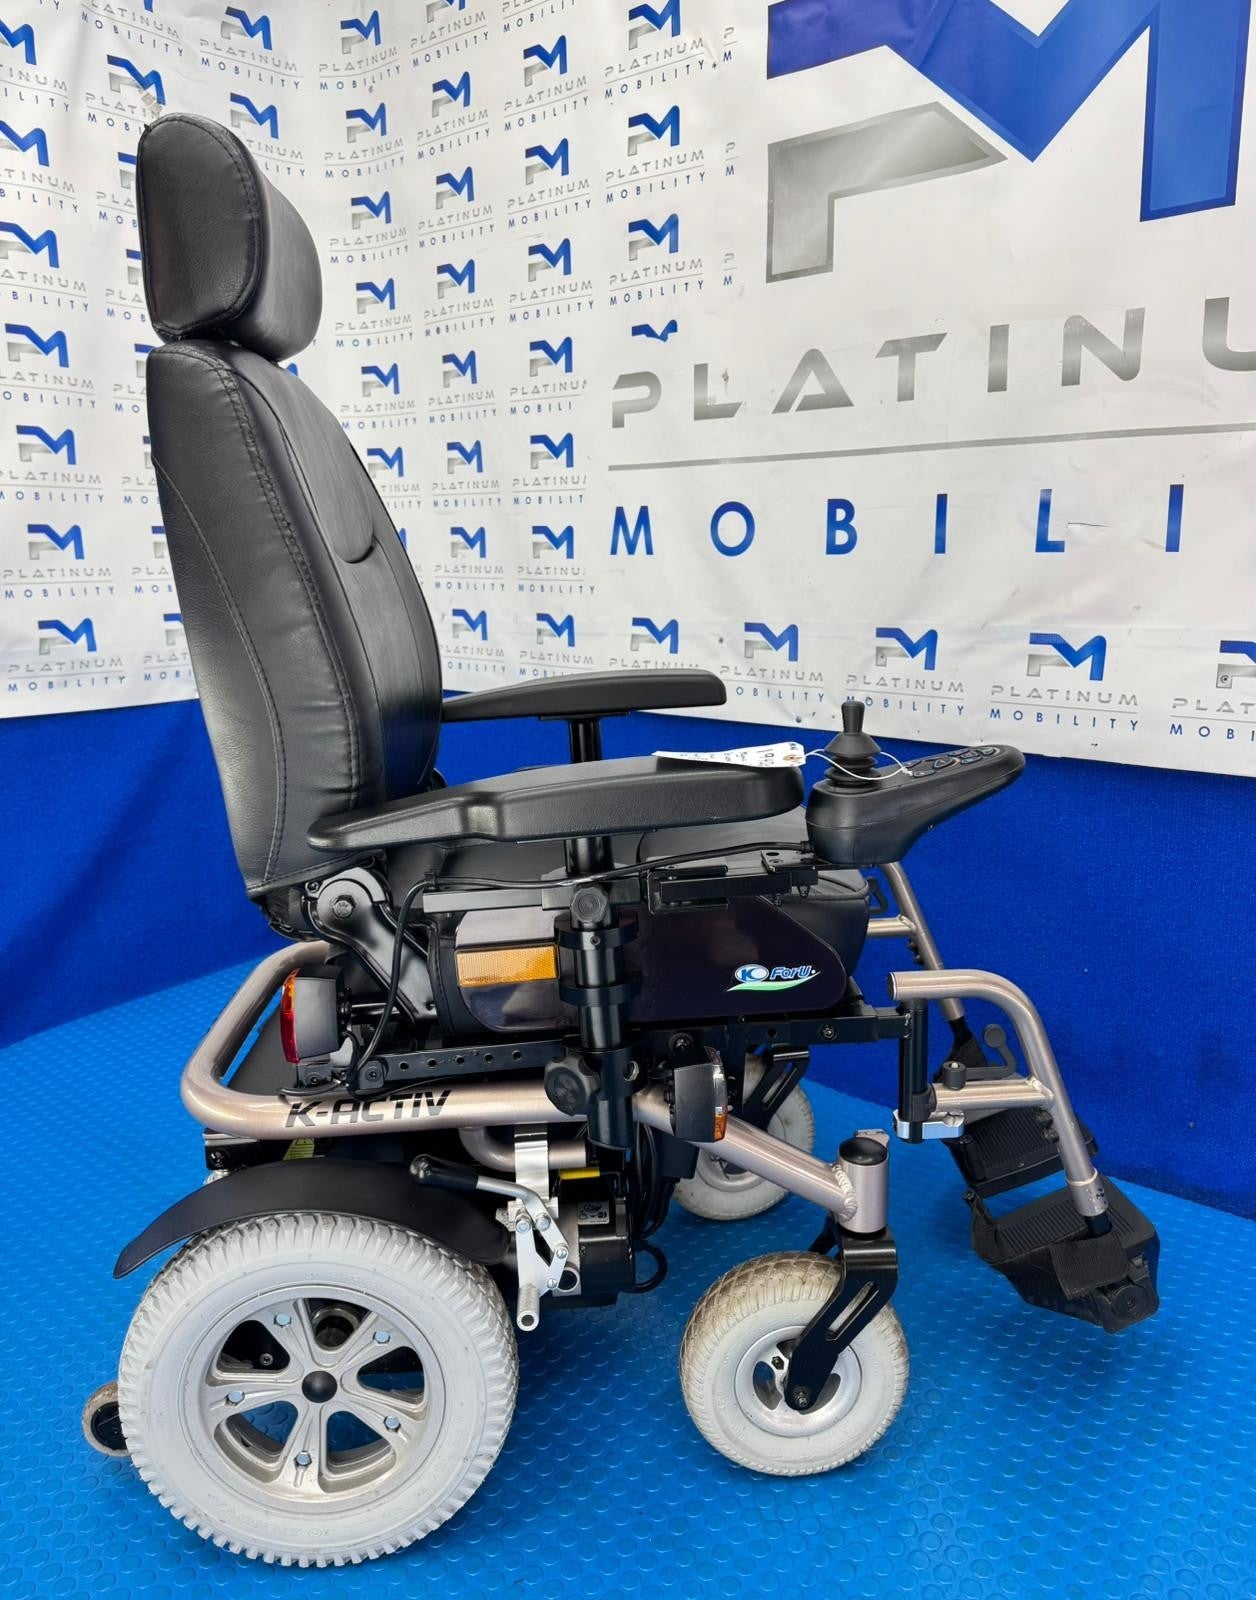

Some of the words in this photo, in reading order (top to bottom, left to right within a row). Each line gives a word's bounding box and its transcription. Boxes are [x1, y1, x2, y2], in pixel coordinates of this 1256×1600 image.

[91, 0, 180, 38] LATINUM
[81, 11, 184, 56] MOBILITY
[410, 12, 486, 48] PLATINUM
[200, 38, 297, 72] PLATINUM
[319, 46, 397, 72] PLATINUM
[413, 32, 489, 67] MOBILITY
[605, 38, 704, 77] PLATINUM
[201, 57, 300, 90] MOBILITY
[320, 65, 401, 90] MOBILITY
[605, 60, 704, 99] MOBILITY
[4, 88, 69, 112] ILITY
[504, 75, 587, 111] PLATINUM
[88, 112, 142, 134] MOBI
[504, 96, 588, 131] MOBILITY
[417, 109, 488, 141] PLATINUM
[246, 139, 304, 160] TINUM
[324, 138, 404, 160] PLATINUM
[418, 128, 489, 159] MOBILITY
[606, 149, 704, 182] PLATINUM
[0, 168, 74, 193] TINUM
[607, 172, 705, 203] MOBILITY
[0, 189, 78, 213] BILITY
[508, 179, 590, 208] PLATINUM
[418, 205, 493, 230] PLATINUM
[508, 199, 591, 228] MOBILITY
[330, 227, 407, 247] PLATINUM
[419, 224, 493, 248] MOBILITY
[0, 268, 86, 291] ATINUM
[610, 258, 702, 285] PLATINUM
[11, 291, 89, 312] BILITY
[509, 280, 592, 303] PLATINUM
[610, 279, 704, 306] MOBILITY
[424, 298, 493, 318] PLATINUM
[509, 300, 593, 322] MOBILITY
[335, 315, 412, 330] PLATINUM
[336, 332, 414, 347] MOBILITY
[612, 296, 1256, 429] PLATINU
[0, 371, 94, 389] LATINUM
[1, 390, 96, 408] OBILITY
[341, 400, 415, 413] PLATINUM
[429, 390, 495, 407] PLATINUM
[511, 402, 572, 414] MOBILI
[341, 418, 416, 430] MOBILITY
[429, 408, 497, 424] MOBILITY
[432, 480, 499, 491] PLATINUM
[433, 497, 502, 507] MOBILITY
[514, 495, 584, 505] MOBILIT
[610, 483, 1184, 556] MOBILI
[3, 568, 112, 579] PLATINUM
[435, 565, 504, 574] PLATINUM
[518, 567, 586, 576] PLATINU
[4, 587, 115, 600] MOBILITY
[435, 581, 505, 590] MOBILITY
[517, 583, 596, 594] MOBILITY
[7, 658, 123, 673] PLATINUM
[144, 652, 188, 664] PLAT
[447, 661, 506, 673] OBILITY
[519, 650, 594, 665] PLATINUM
[8, 676, 126, 692] MOBILITY
[144, 670, 192, 681] MOBI
[721, 666, 824, 681] PLATINUM
[847, 675, 964, 693] PLATINUM
[735, 686, 824, 703] OBILITY
[992, 685, 1138, 706] PLATINUM
[1173, 698, 1256, 716] PLAT
[990, 708, 1138, 731] MOBILITY
[1170, 724, 1256, 741] MOBI
[285, 1089, 452, 1128] K-ACTIV
